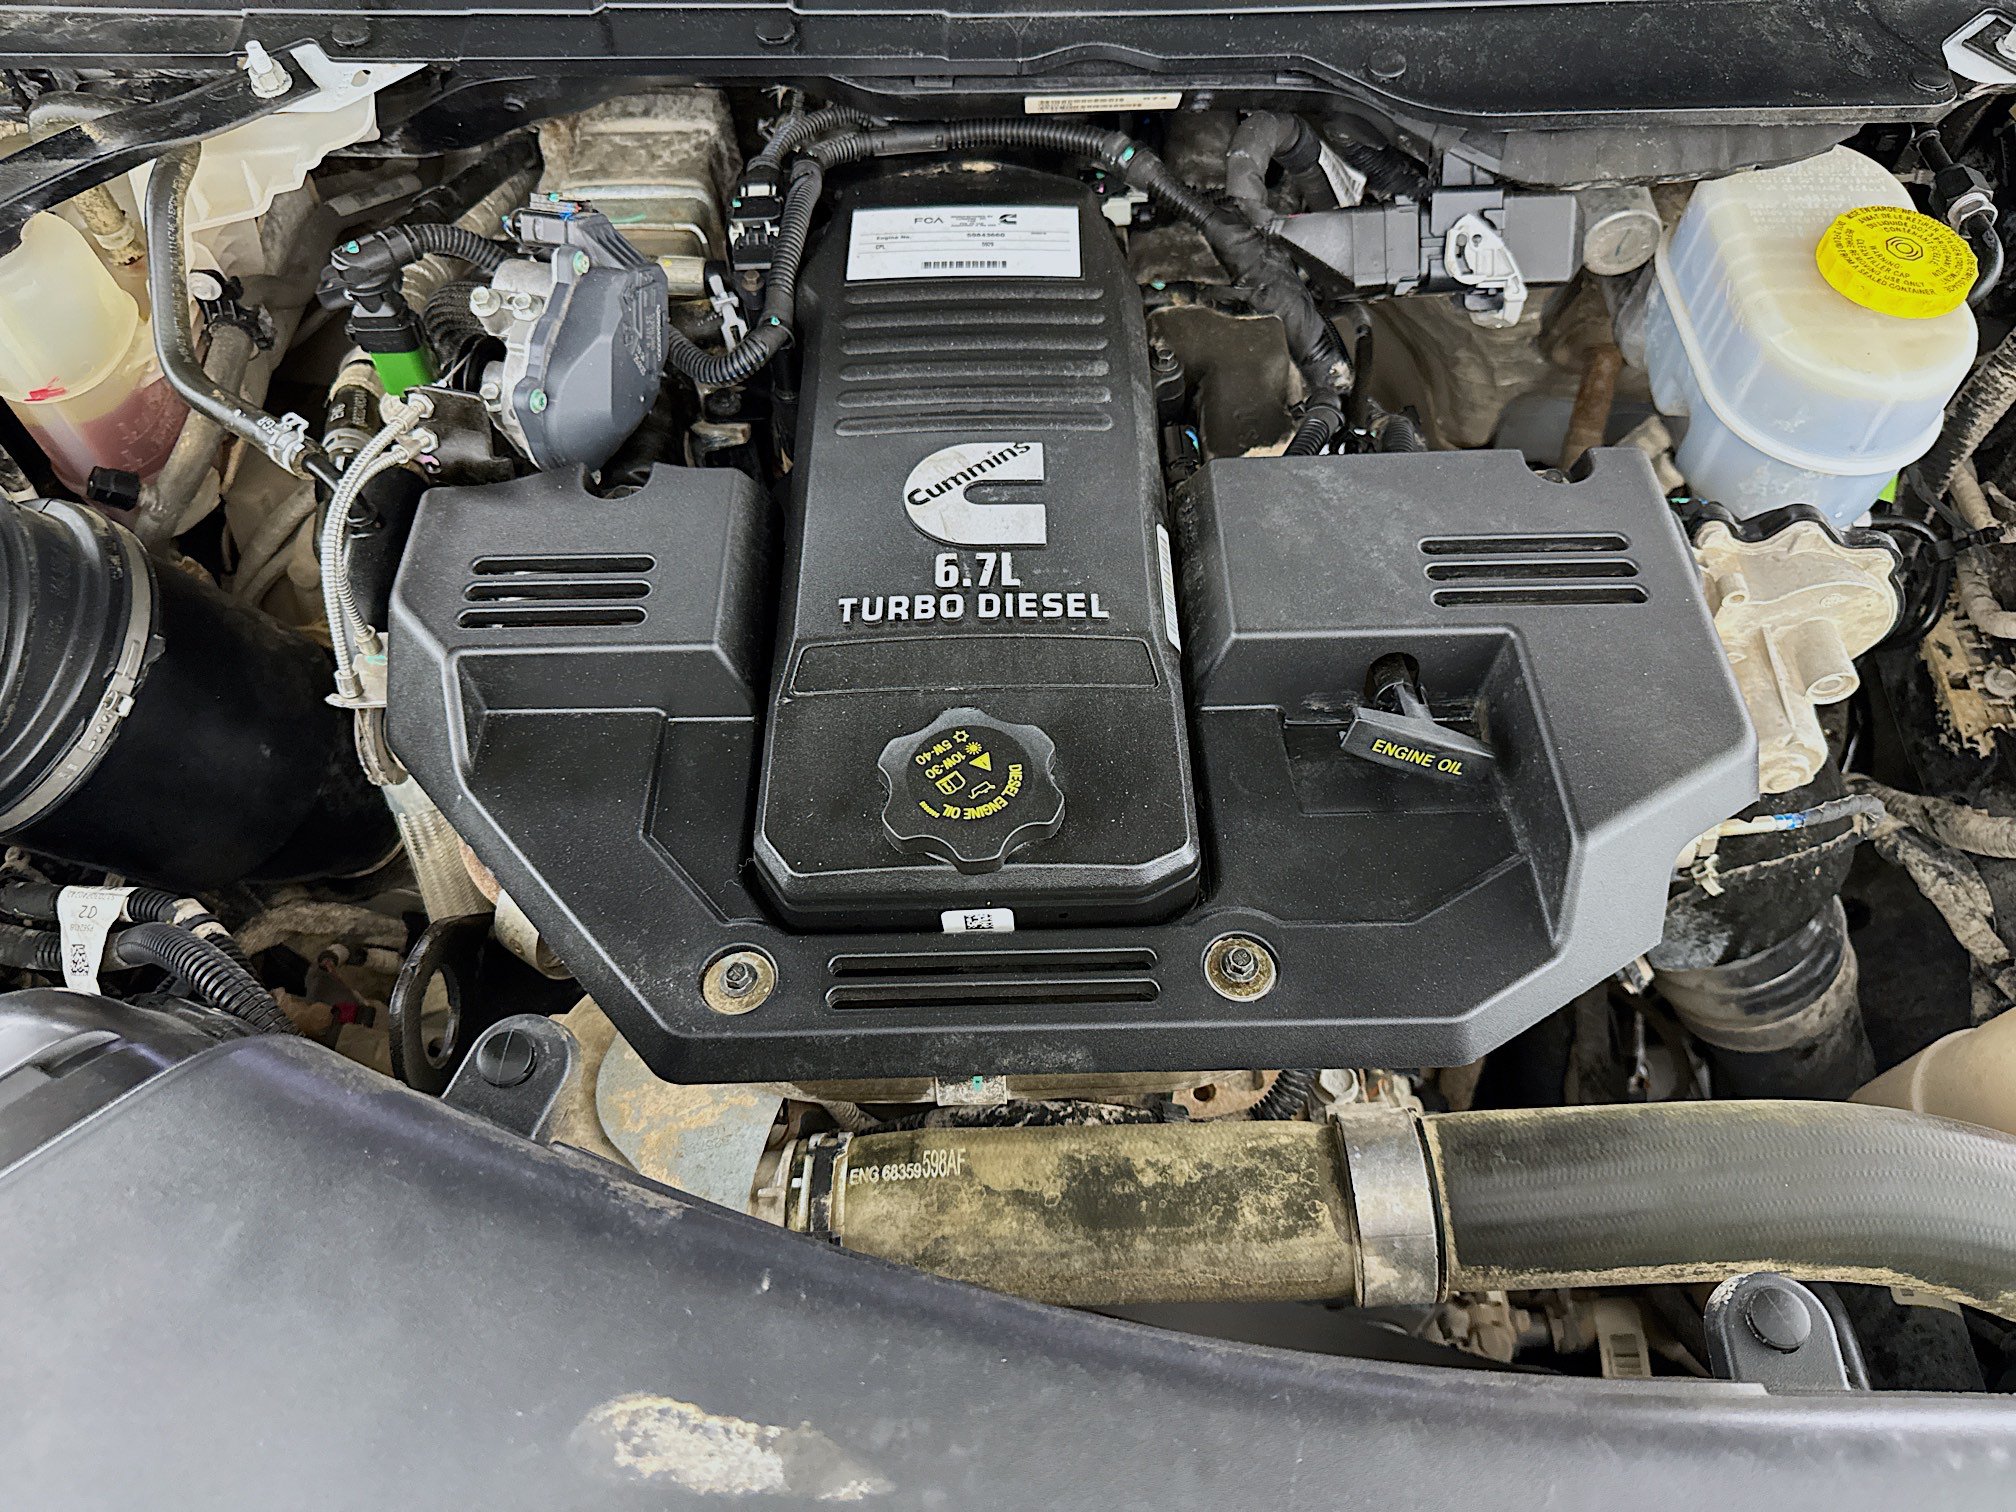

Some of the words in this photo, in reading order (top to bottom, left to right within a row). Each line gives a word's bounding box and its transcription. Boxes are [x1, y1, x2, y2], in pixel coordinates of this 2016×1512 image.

[1857, 268, 1887, 286] SEALED
[1865, 256, 1891, 273] FILLER
[1892, 270, 1910, 279] CAP
[906, 442, 1031, 506] Cummins
[934, 552, 1021, 589] 6.7L
[838, 593, 965, 624] TURBO
[977, 592, 1111, 620] DIESEL
[915, 739, 953, 766] 5W-40
[924, 751, 967, 780] 10W-30
[1371, 738, 1437, 768] ENGINE
[1437, 758, 1463, 776] OIL
[1001, 763, 1023, 798] DIESEL
[942, 803, 961, 819] OIL
[962, 795, 1009, 820] ENGINE
[849, 1165, 880, 1186] ENG
